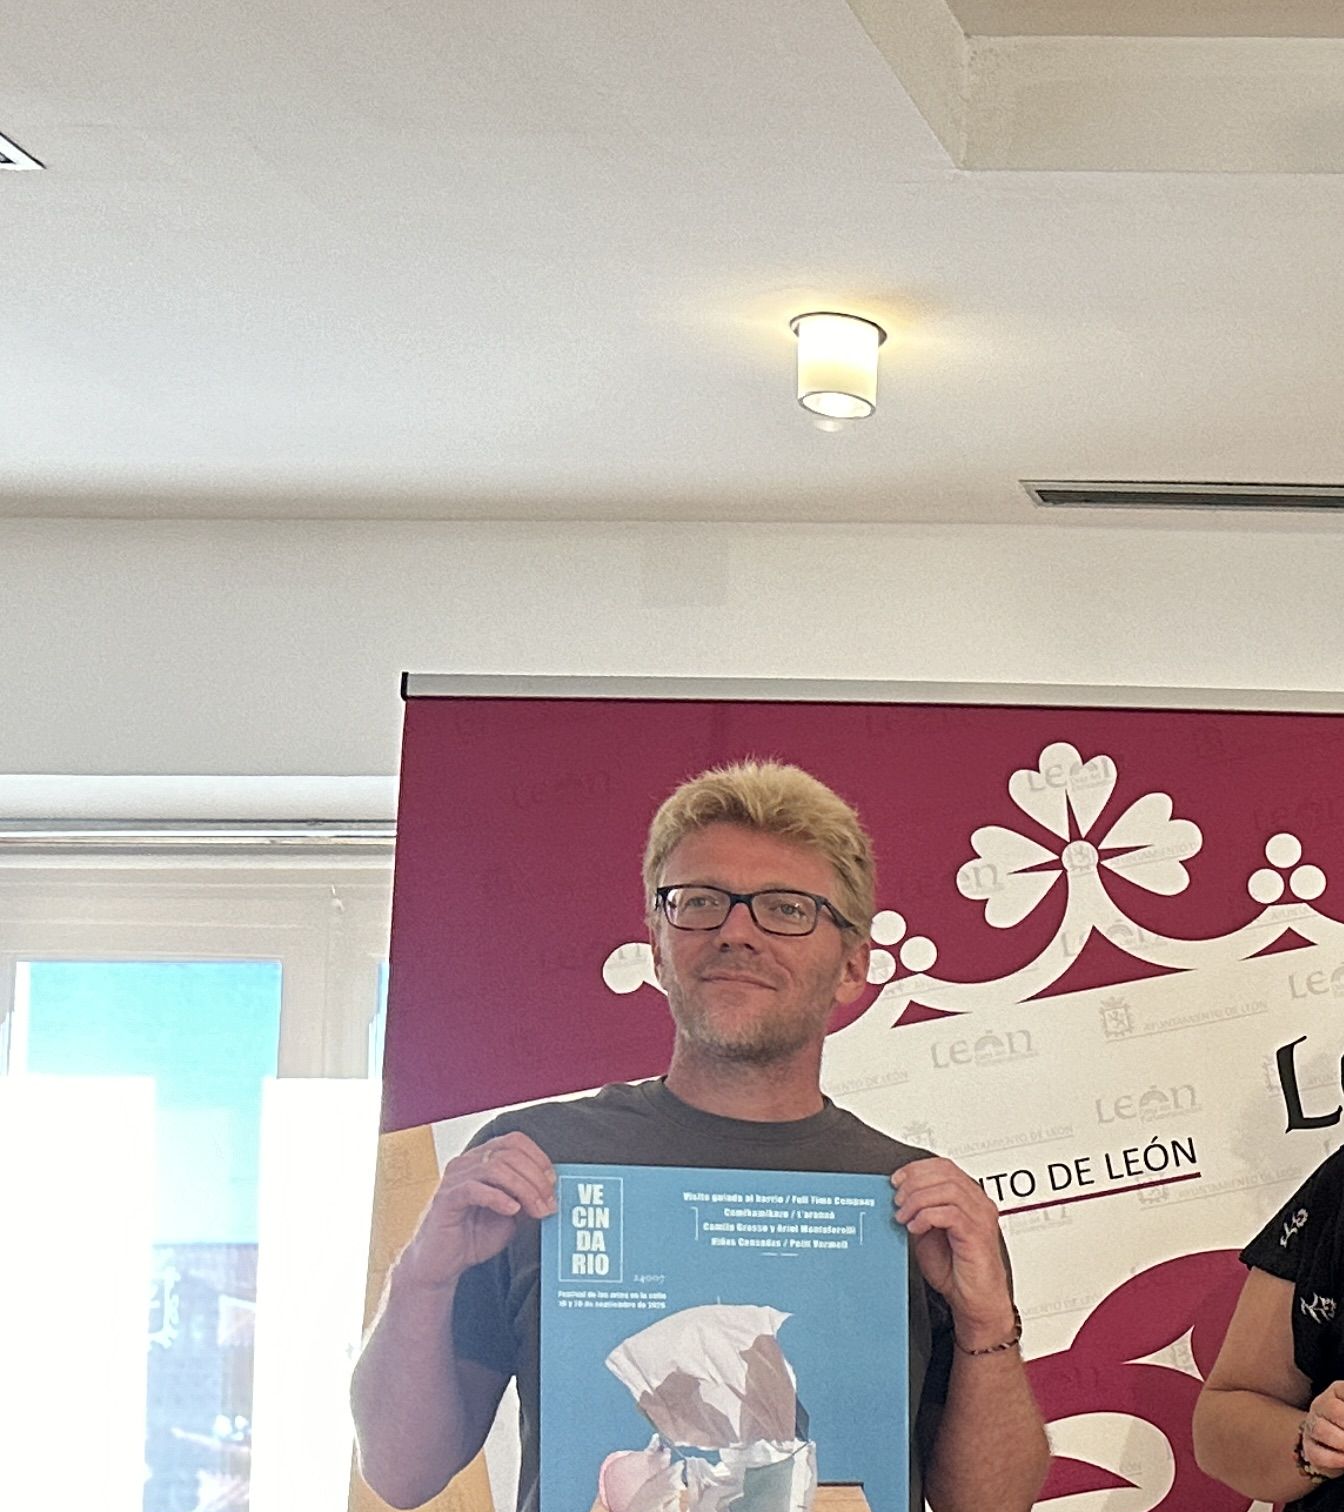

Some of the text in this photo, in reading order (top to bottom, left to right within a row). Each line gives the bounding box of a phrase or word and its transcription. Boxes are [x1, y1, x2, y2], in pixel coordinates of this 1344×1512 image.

[1047, 1157, 1095, 1191] DE
[1104, 1135, 1197, 1180] LEÓN
[577, 1183, 604, 1205] VE
[572, 1207, 610, 1229] CIN
[576, 1231, 606, 1252] DA
[572, 1253, 609, 1276] RIO
